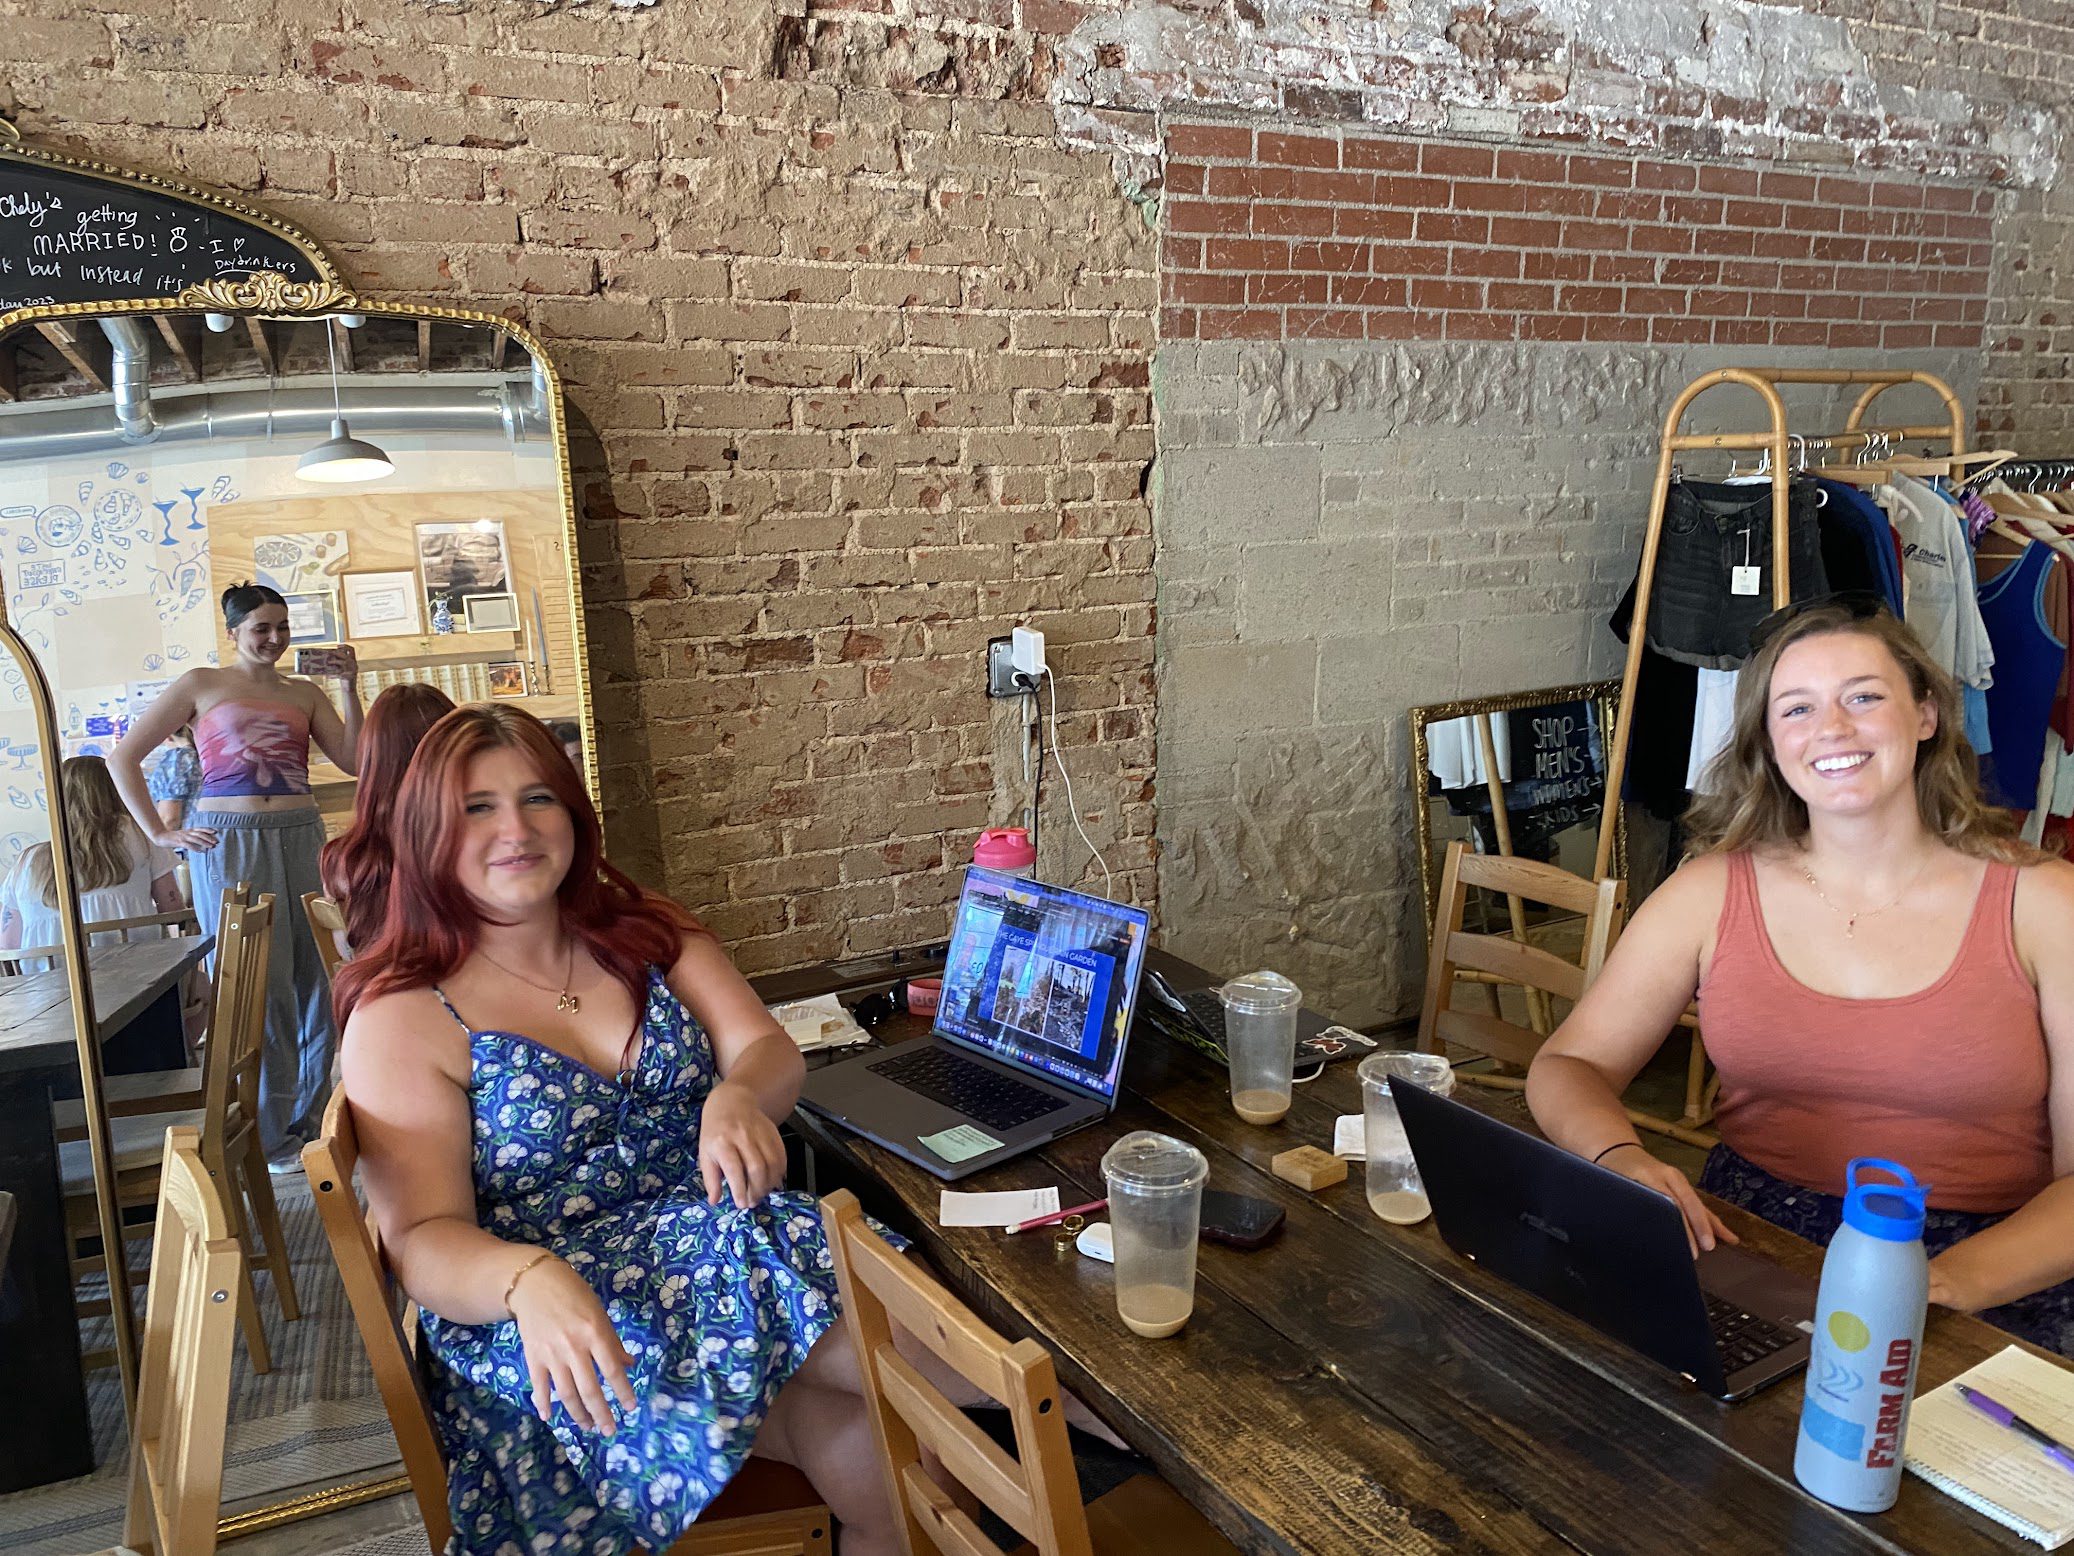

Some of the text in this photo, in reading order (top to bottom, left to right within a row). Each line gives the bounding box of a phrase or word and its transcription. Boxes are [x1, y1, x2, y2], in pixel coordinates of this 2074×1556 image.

[77, 203, 138, 236] getting
[34, 232, 157, 256] MARRIED!
[26, 256, 62, 278] but
[23, 295, 55, 307] 2023
[1531, 715, 1575, 749] SHOP
[1535, 746, 1585, 779] MEN'S
[1069, 953, 1098, 967] GARDEN
[1866, 1393, 1905, 1470] FARM
